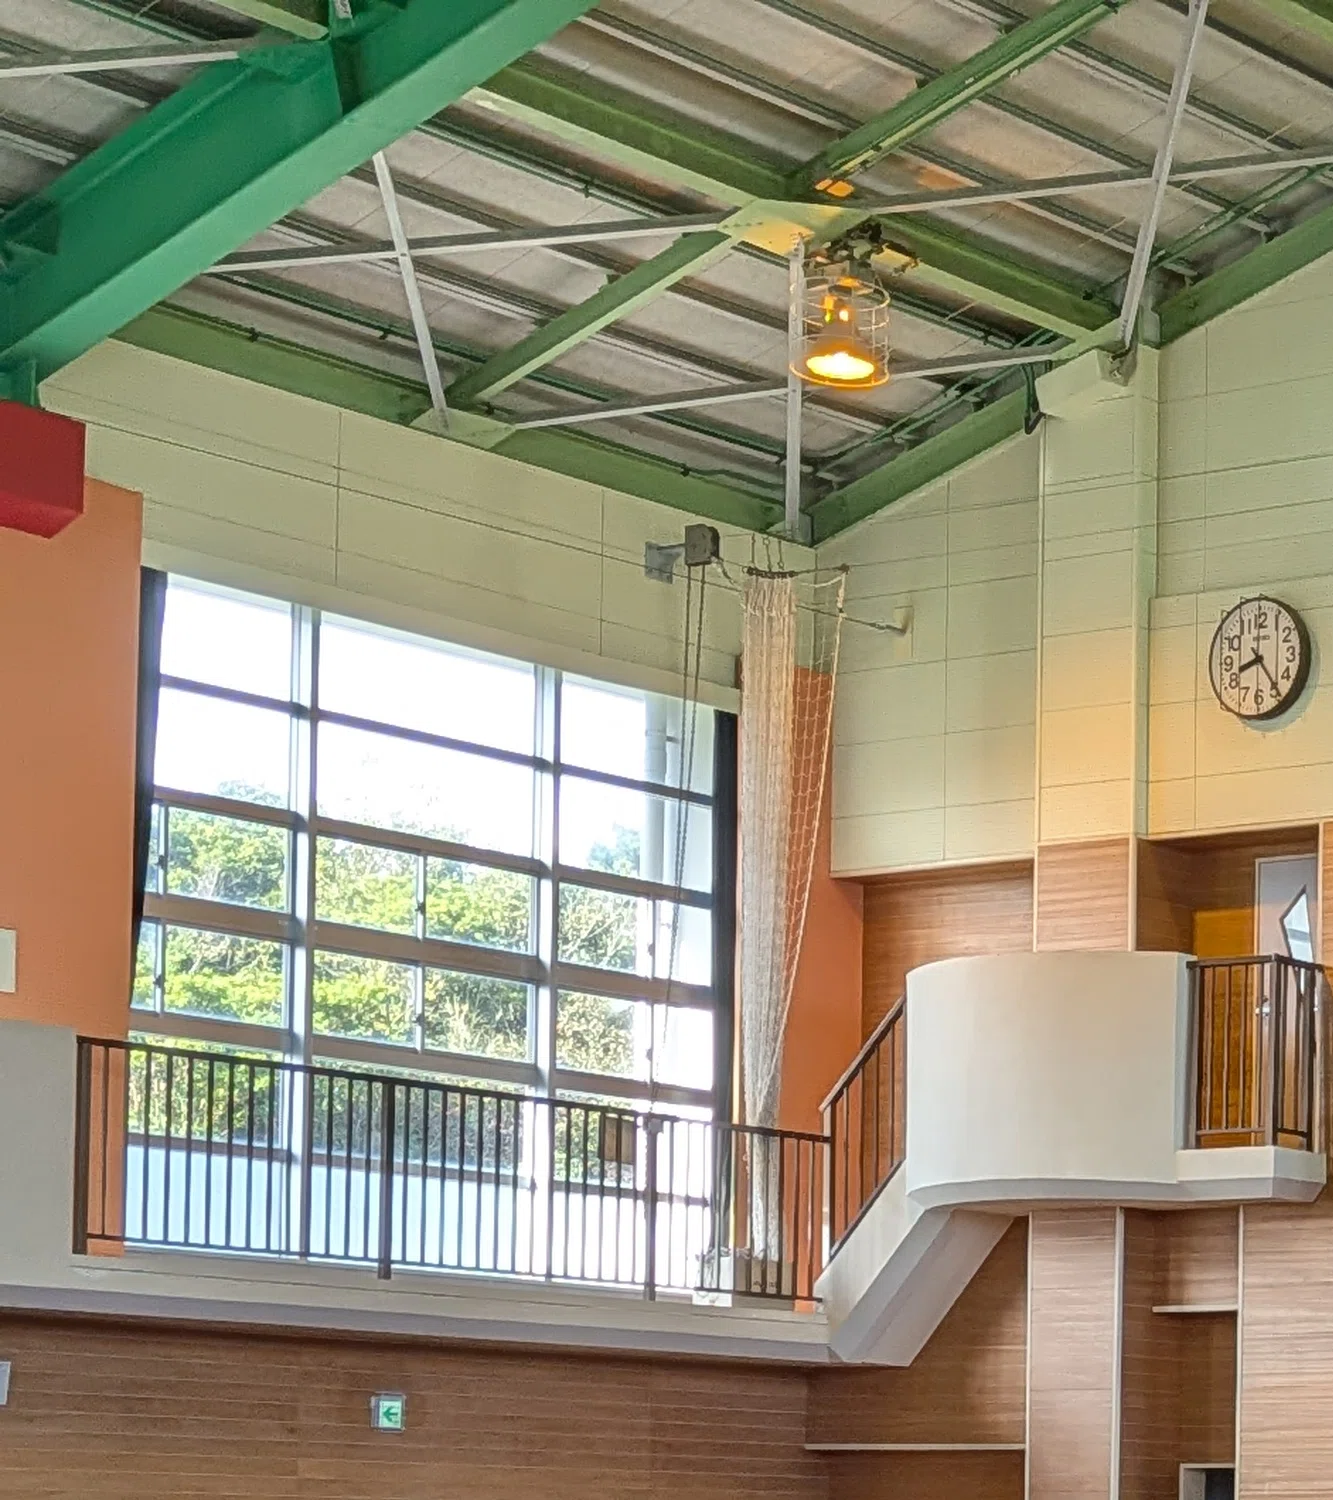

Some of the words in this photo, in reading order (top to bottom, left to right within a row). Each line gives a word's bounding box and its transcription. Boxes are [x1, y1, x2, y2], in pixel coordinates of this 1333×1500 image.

[1240, 619, 1251, 635] 11
[1254, 612, 1268, 629] 12
[1225, 634, 1240, 652] 10
[1282, 626, 1292, 643] 2
[1286, 646, 1296, 663] 3
[1224, 655, 1234, 672] 9
[1229, 672, 1240, 689] 8
[1281, 666, 1291, 681] 4
[1240, 686, 1250, 702] 7
[1254, 689, 1264, 706] 6
